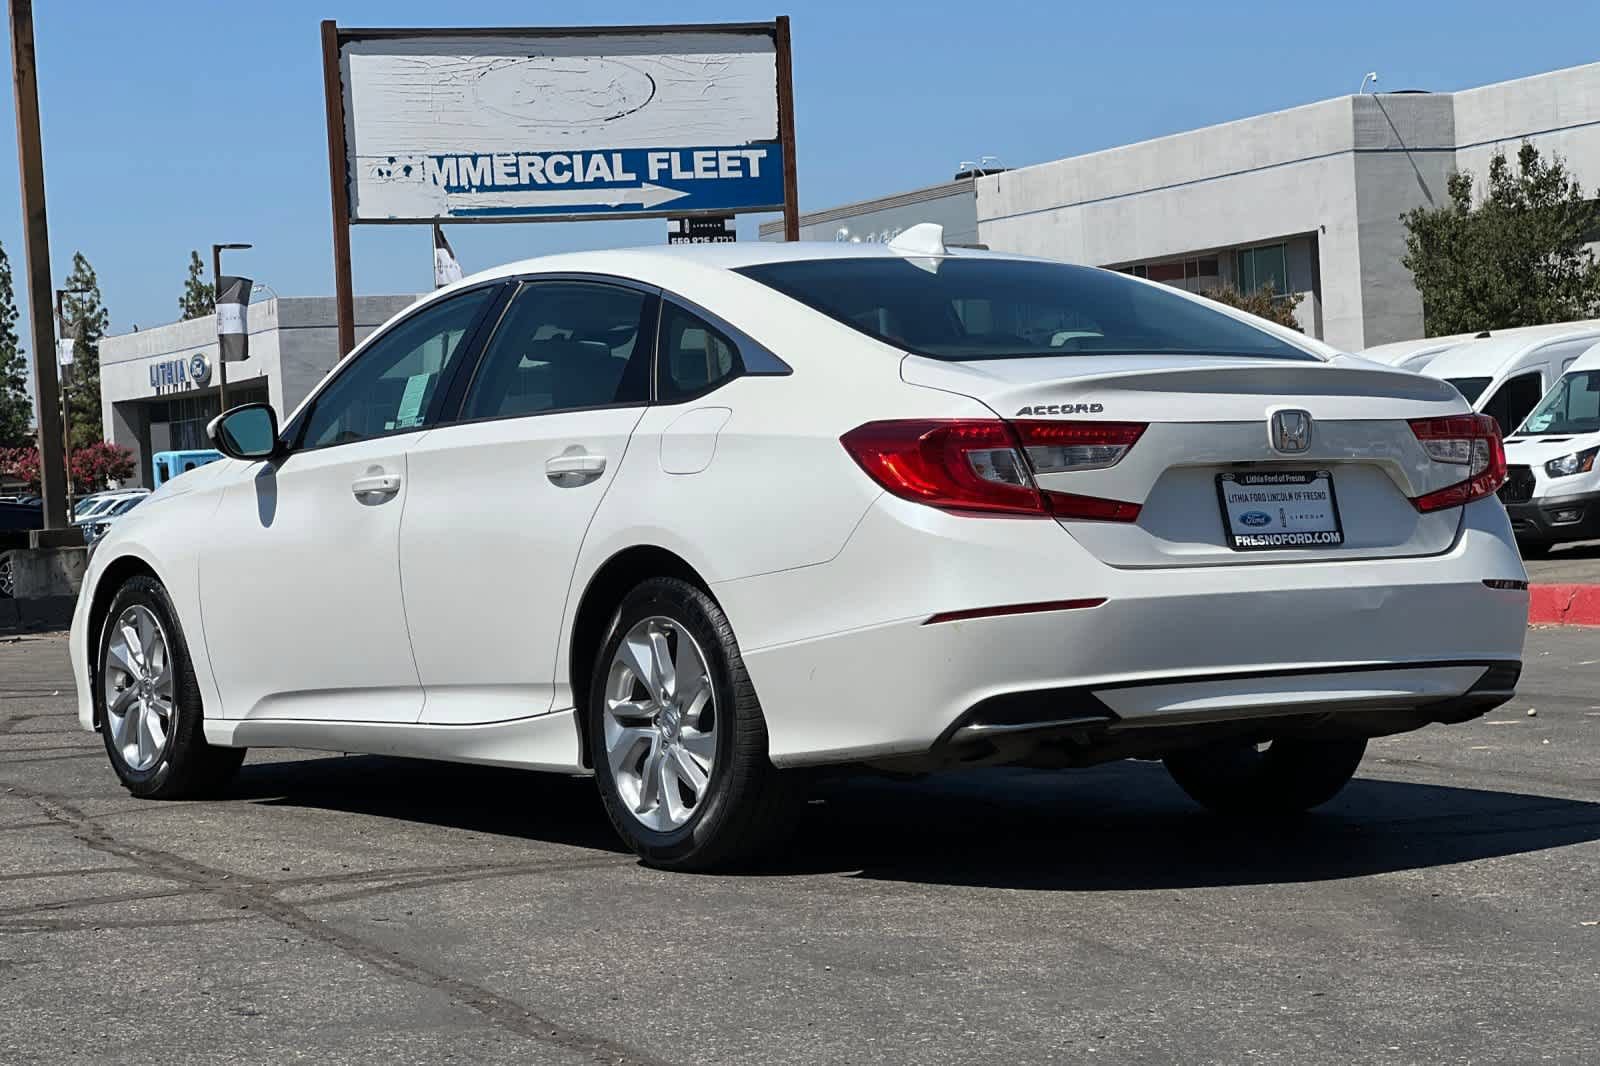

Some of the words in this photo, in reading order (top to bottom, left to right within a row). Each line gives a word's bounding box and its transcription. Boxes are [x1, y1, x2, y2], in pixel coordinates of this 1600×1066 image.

[648, 149, 768, 180] FLEET
[150, 359, 190, 387] LITHIA
[1016, 403, 1104, 416] ACCORD
[1229, 493, 1249, 504] LITHIA
[1250, 493, 1266, 503] FORD
[1304, 491, 1327, 500] FRESNO
[1234, 532, 1341, 546] FRESNOFORD.COM
